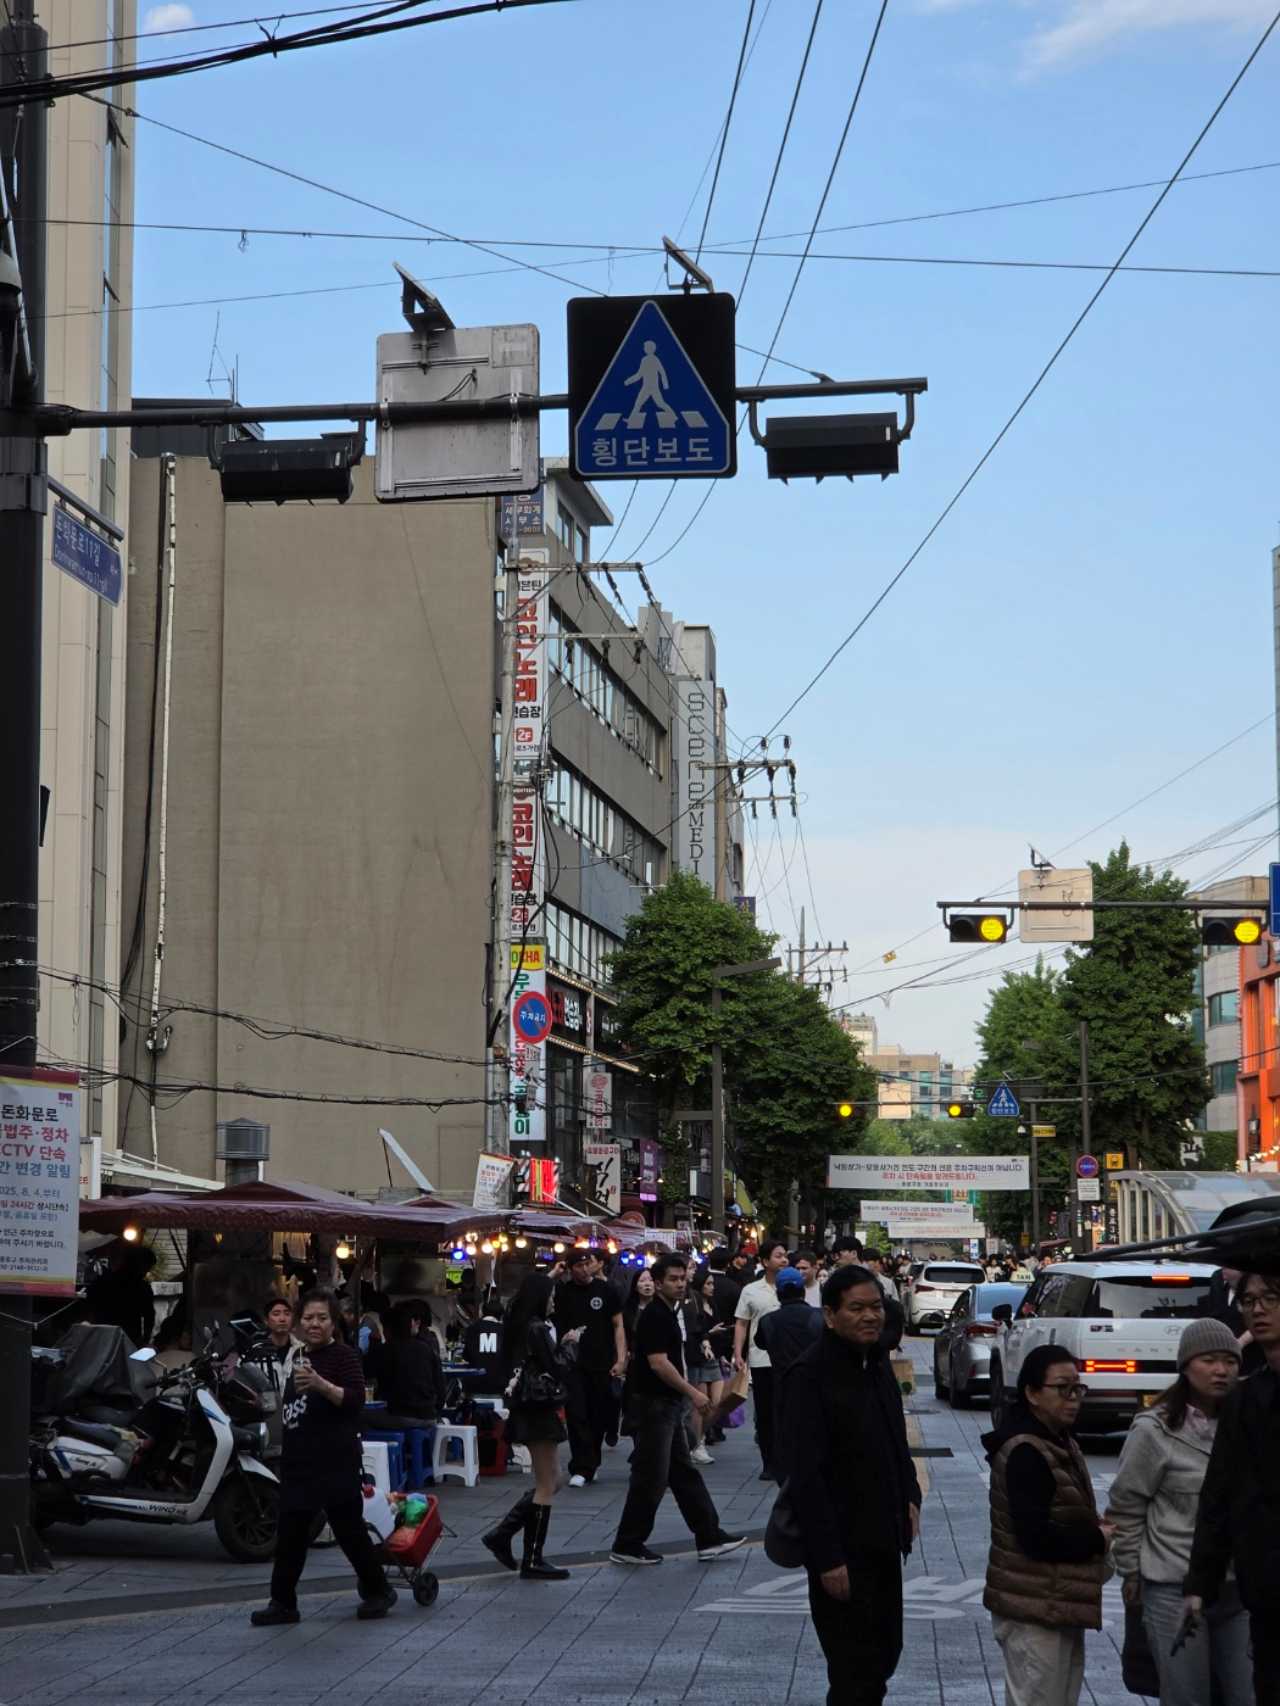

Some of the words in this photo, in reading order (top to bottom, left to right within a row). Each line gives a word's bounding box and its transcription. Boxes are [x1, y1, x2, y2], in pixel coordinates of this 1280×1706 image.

[592, 437, 713, 467] 횡단보도
[1, 1104, 60, 1122] 돈화문로
[0, 1123, 70, 1144] 법주·정차
[39, 1145, 66, 1162] 단속
[15, 1162, 42, 1177] 변경
[46, 1163, 71, 1179] 알림
[479, 1332, 497, 1353] M
[149, 1503, 177, 1513] WIND
